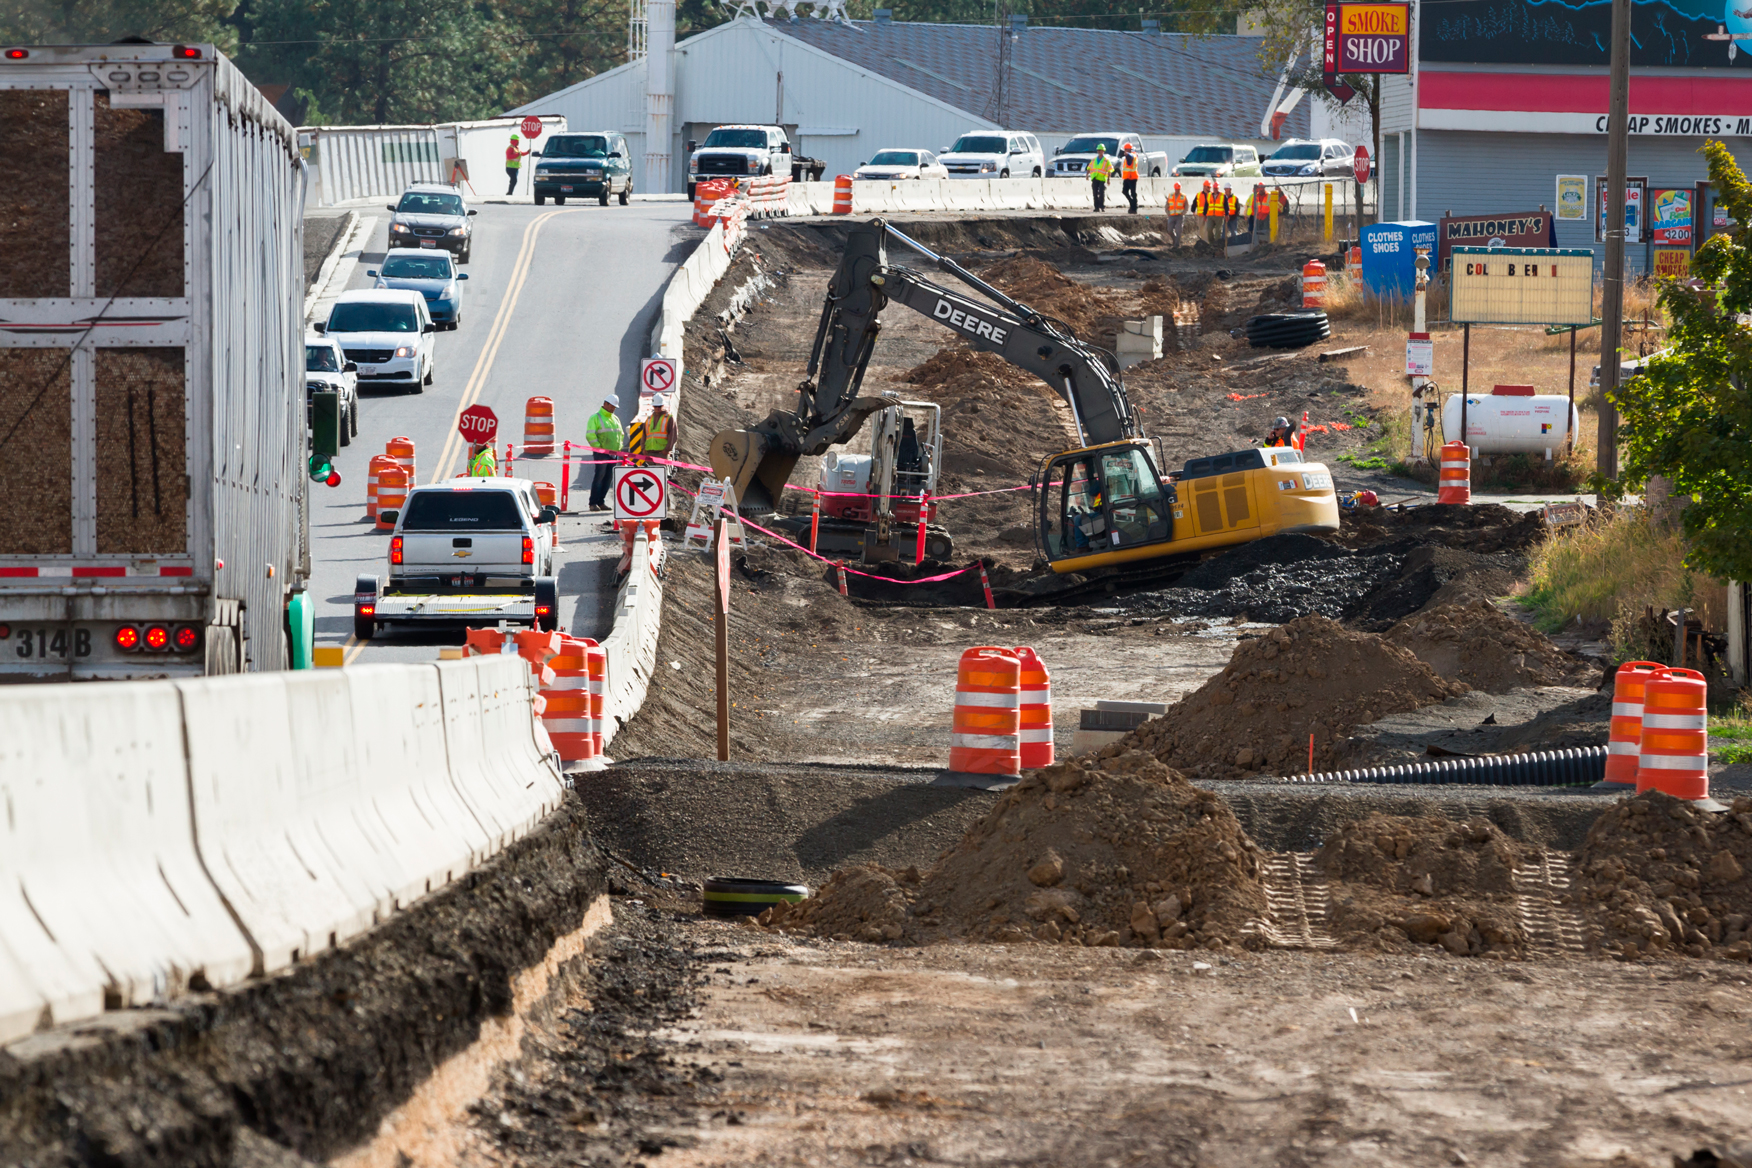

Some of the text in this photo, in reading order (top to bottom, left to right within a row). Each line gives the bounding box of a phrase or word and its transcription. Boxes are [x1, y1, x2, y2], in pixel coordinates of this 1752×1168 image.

[1347, 10, 1400, 32] SMOKE
[1326, 12, 1335, 63] OPEN
[1346, 37, 1401, 64] SHOP
[522, 121, 541, 132] STOP
[1654, 117, 1722, 134] SMOKES
[1355, 157, 1369, 171] STOP
[1447, 217, 1543, 240] MAHONEY'S
[1654, 217, 1692, 230] BARGAIN
[1368, 231, 1404, 243] CLOTHES
[1412, 232, 1436, 244] CLOTHES
[1372, 241, 1400, 253] SHOES
[1659, 251, 1684, 264] CHEAP
[1466, 263, 1489, 275] COL
[933, 299, 1007, 345] DEERE
[460, 414, 496, 433] STOP
